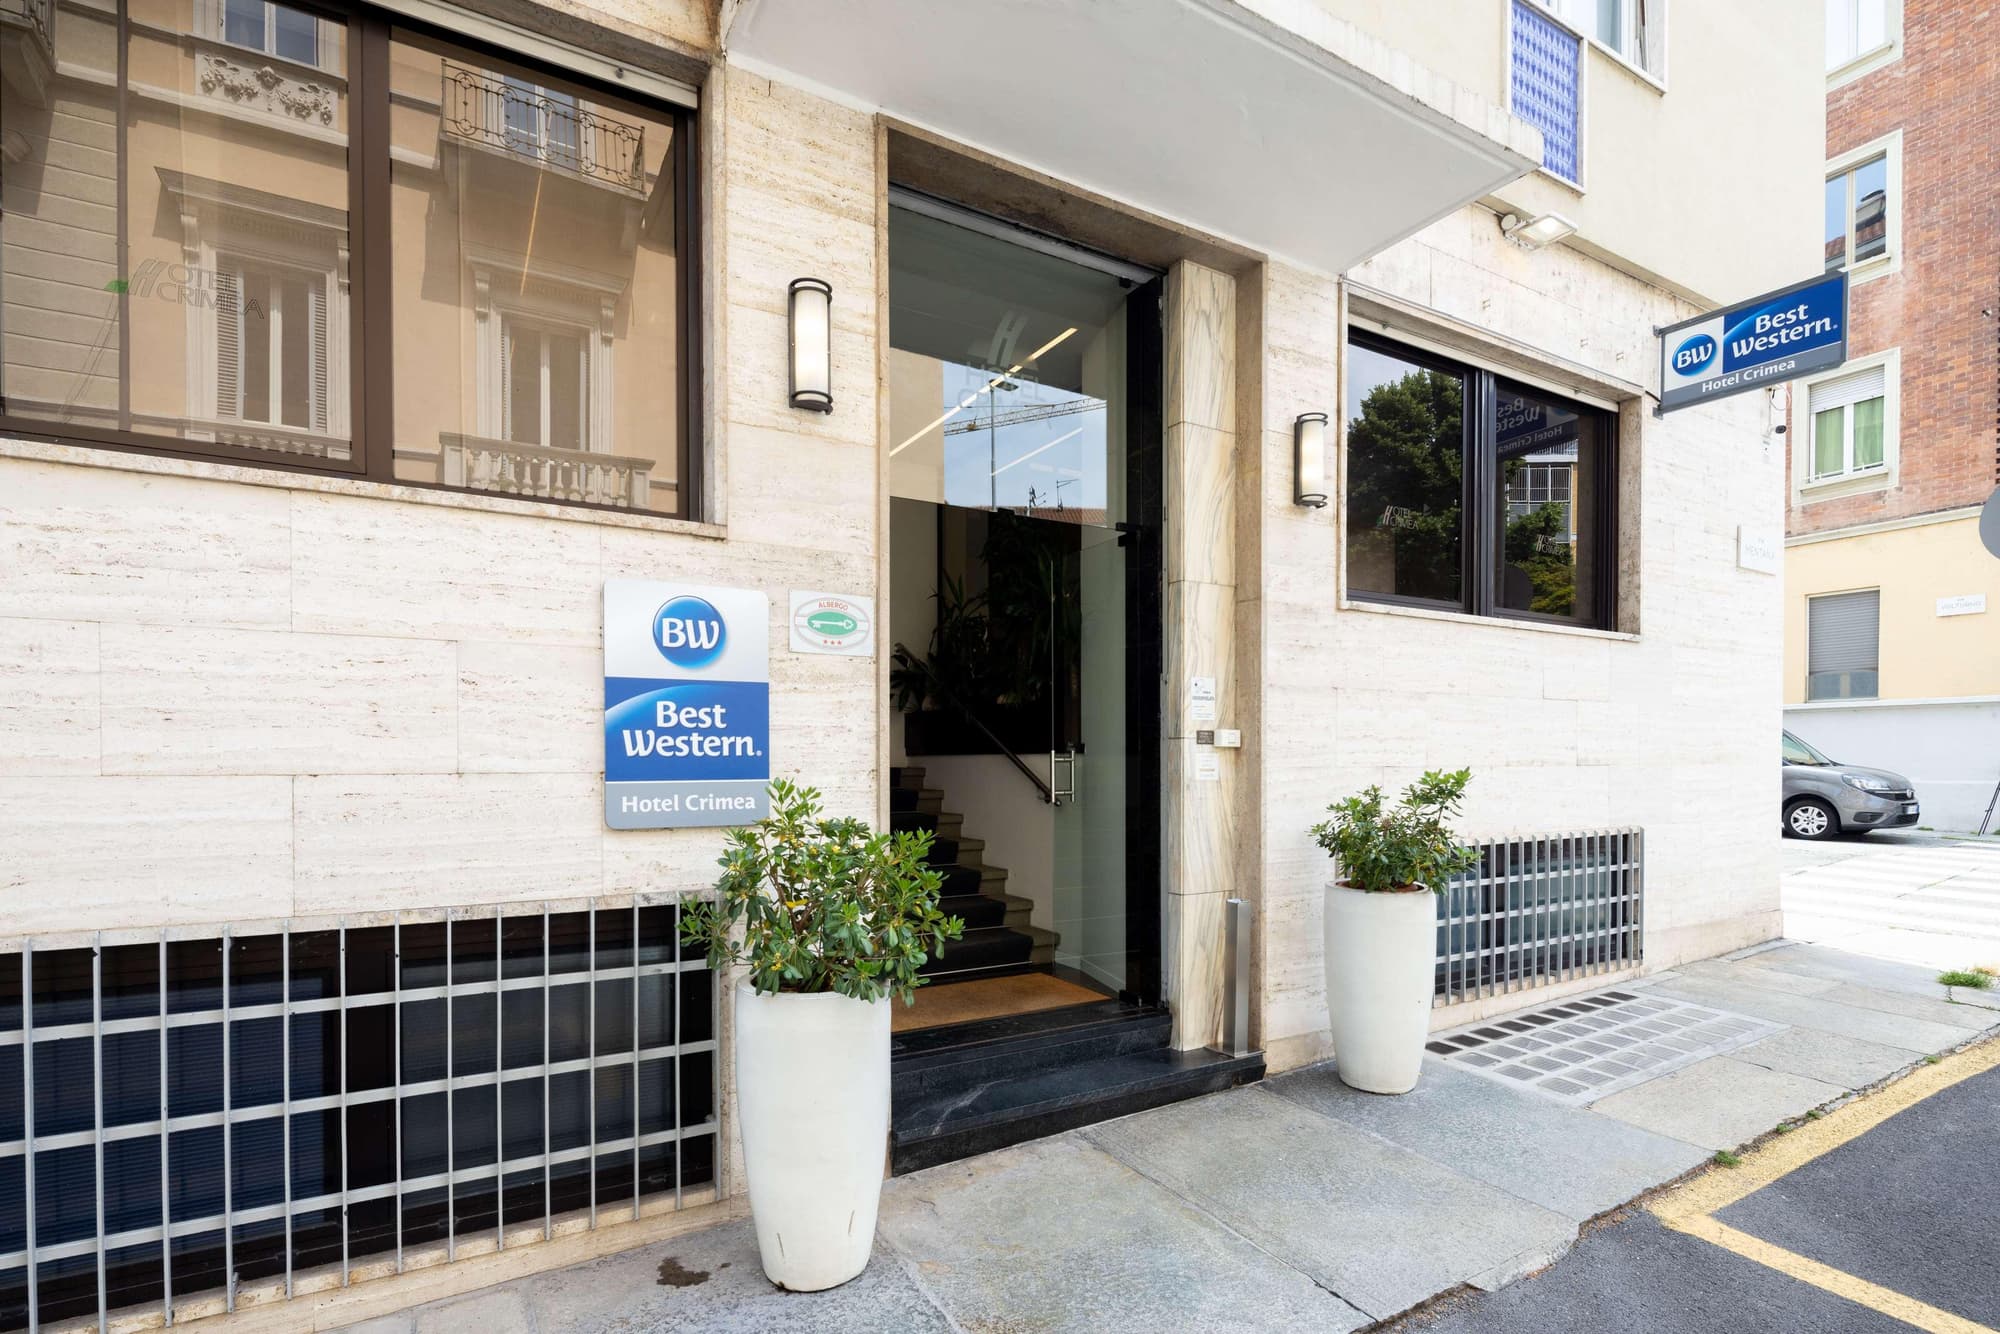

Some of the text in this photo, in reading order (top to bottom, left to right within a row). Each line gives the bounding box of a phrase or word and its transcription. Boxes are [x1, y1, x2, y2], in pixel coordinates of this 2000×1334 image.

[1755, 303, 1809, 334] Best
[1677, 343, 1713, 369] BW
[1702, 360, 1796, 393] Hotel Crimea
[818, 600, 849, 611] ALBERGO
[661, 617, 720, 650] BW
[656, 700, 727, 729] Best
[621, 793, 756, 813] Hotel Crimea
